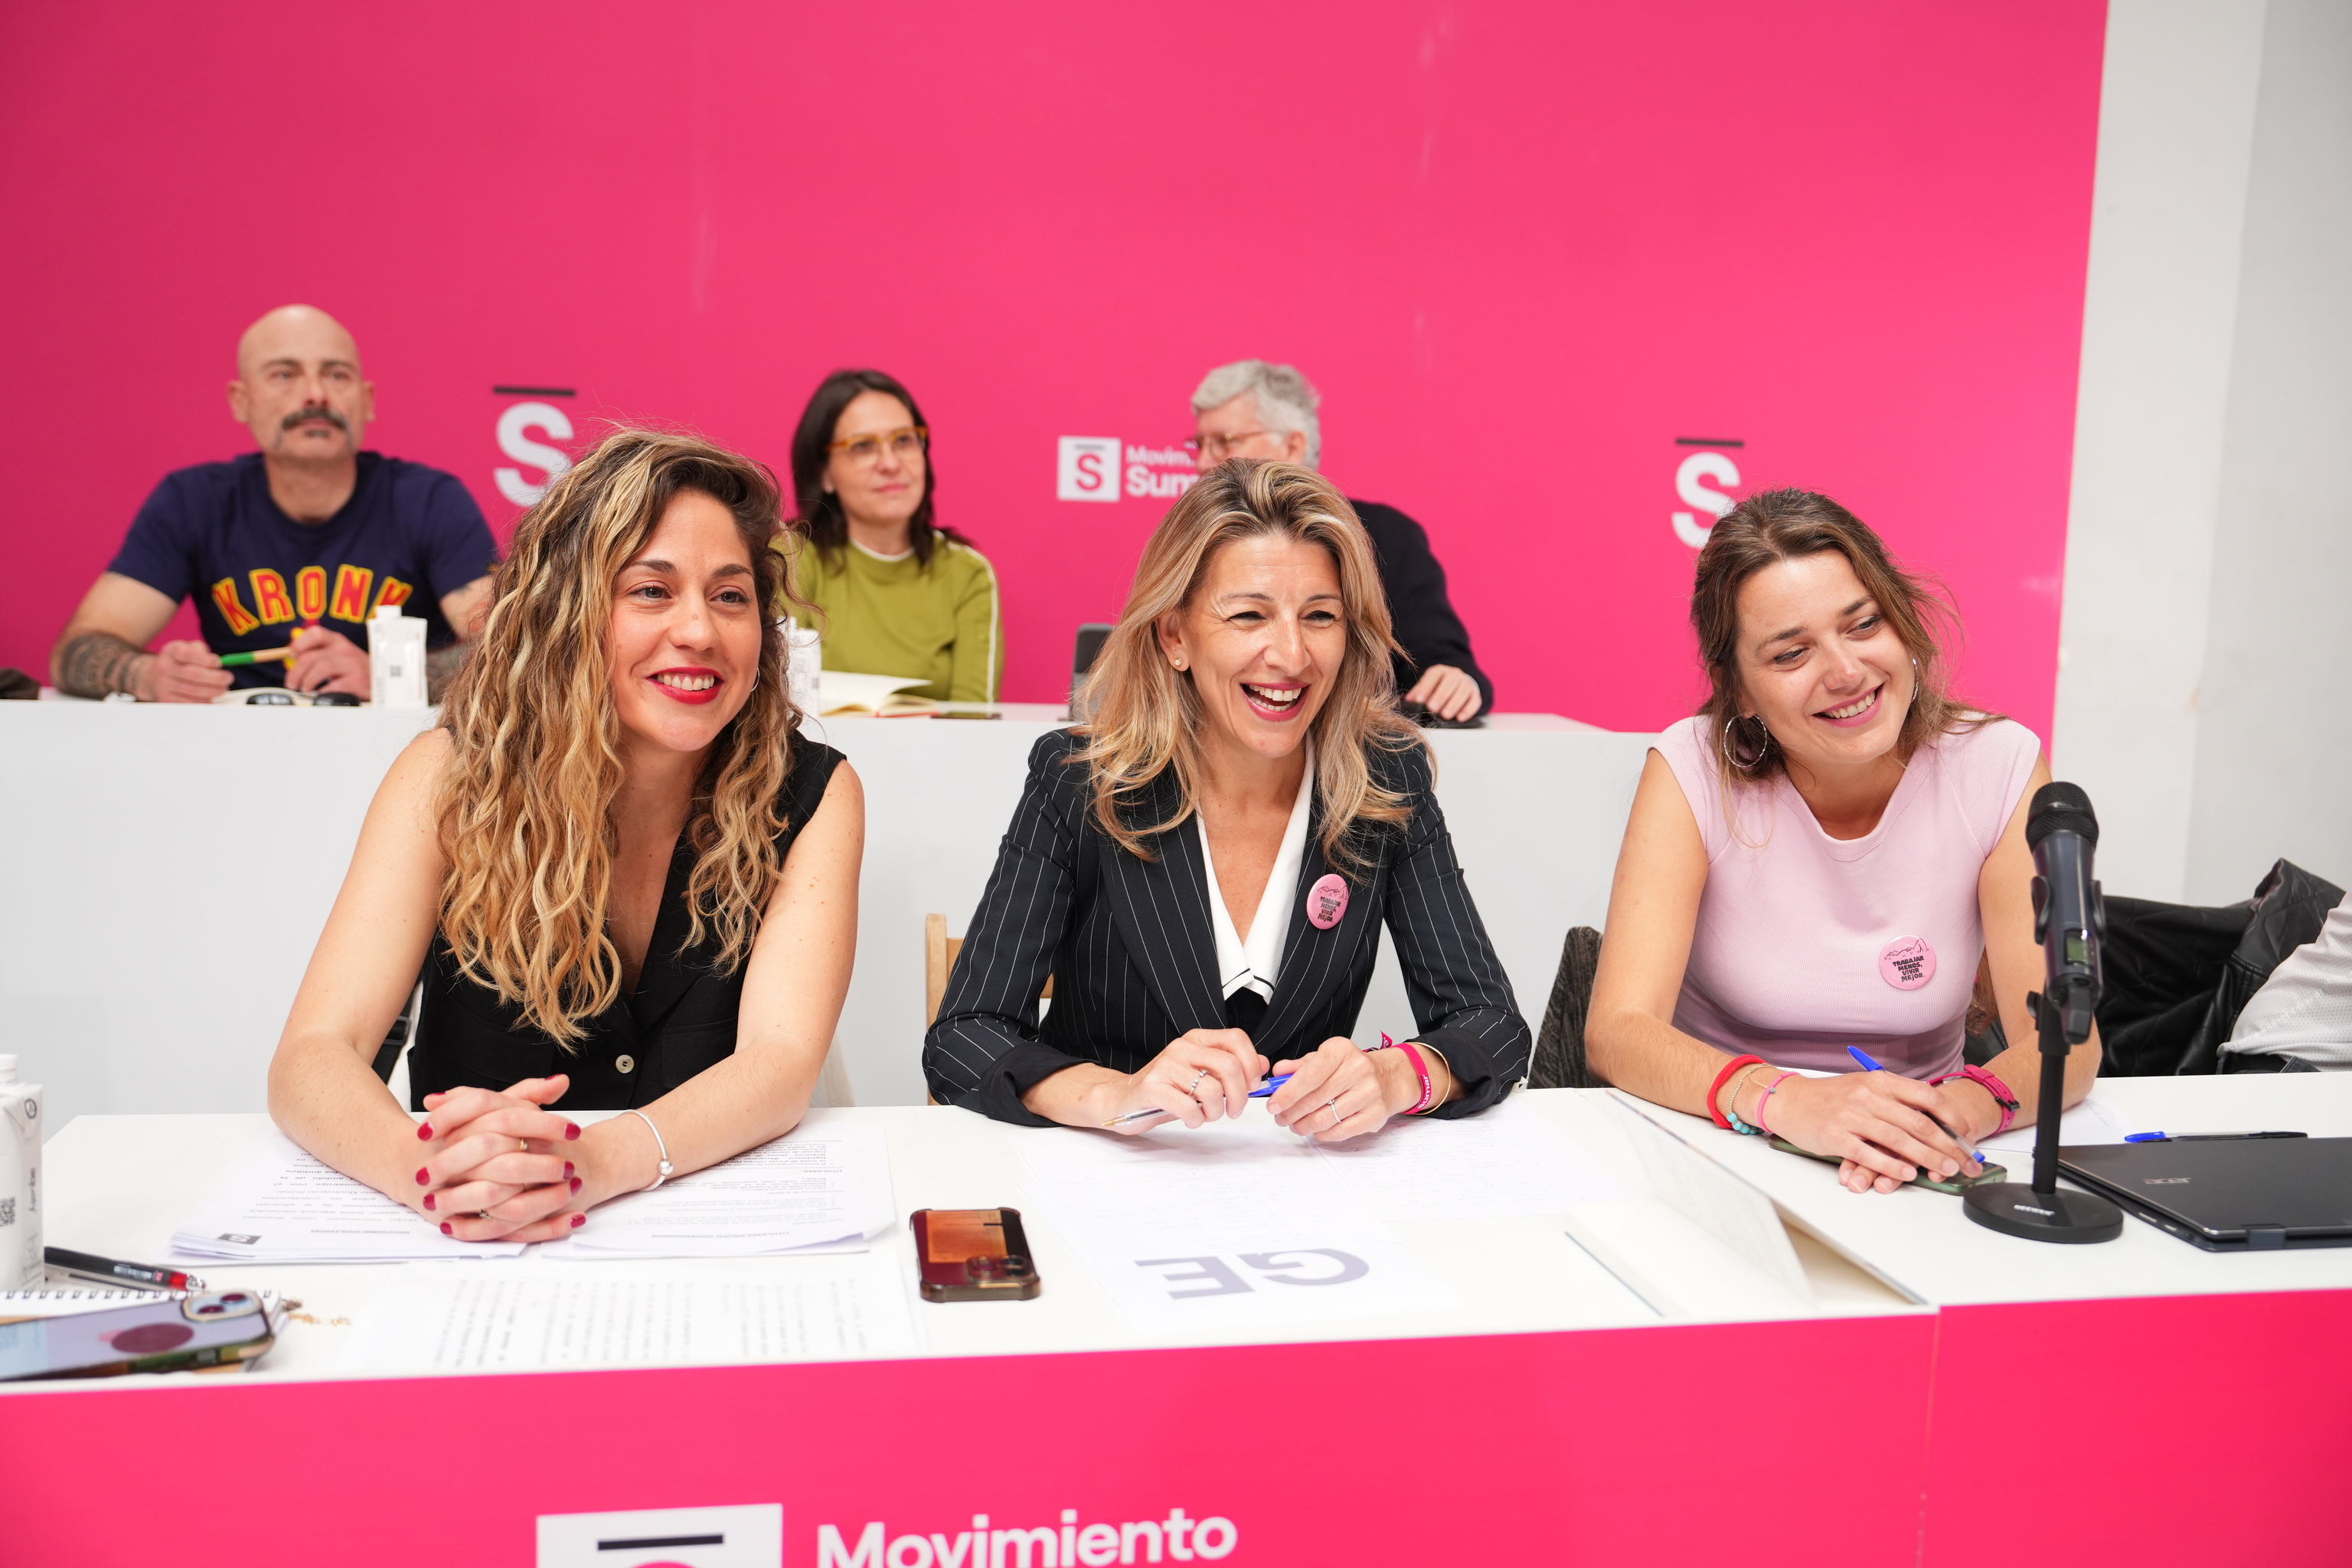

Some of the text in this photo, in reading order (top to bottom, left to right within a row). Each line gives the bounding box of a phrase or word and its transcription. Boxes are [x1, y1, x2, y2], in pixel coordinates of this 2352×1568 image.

[1127, 464, 1200, 497] Sum
[1893, 956, 1924, 967] TRABAJAR
[818, 1508, 1238, 1568] Movimiento
